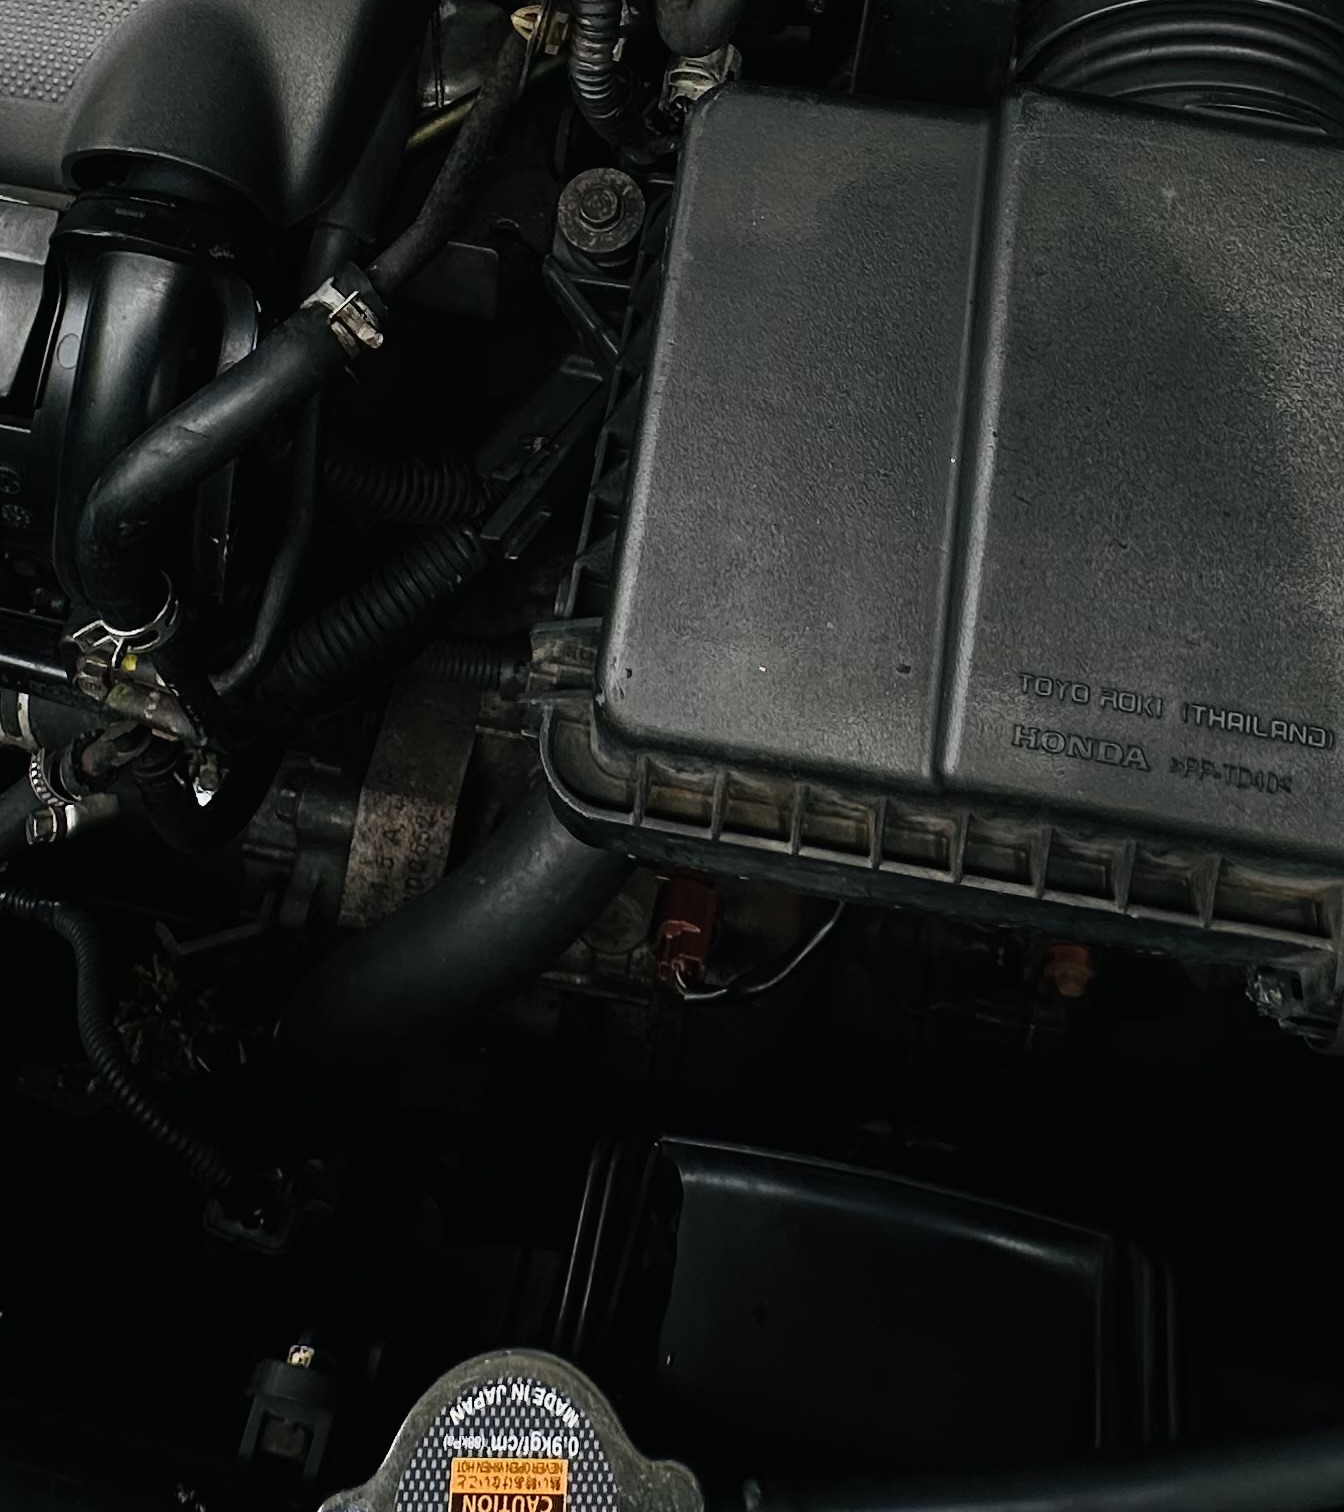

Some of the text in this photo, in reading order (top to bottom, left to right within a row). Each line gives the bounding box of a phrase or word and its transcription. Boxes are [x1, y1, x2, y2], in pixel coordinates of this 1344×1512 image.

[1019, 673, 1090, 704] TOYO
[1100, 687, 1163, 718] ROKI
[1184, 703, 1336, 749] (THAILAND)
[1012, 724, 1150, 772] HONDA
[450, 1383, 580, 1429] MADE IN JAPAN
[456, 1461, 563, 1475] NEVER OPEN WHEN HOT
[462, 1495, 554, 1512] CAUTION
